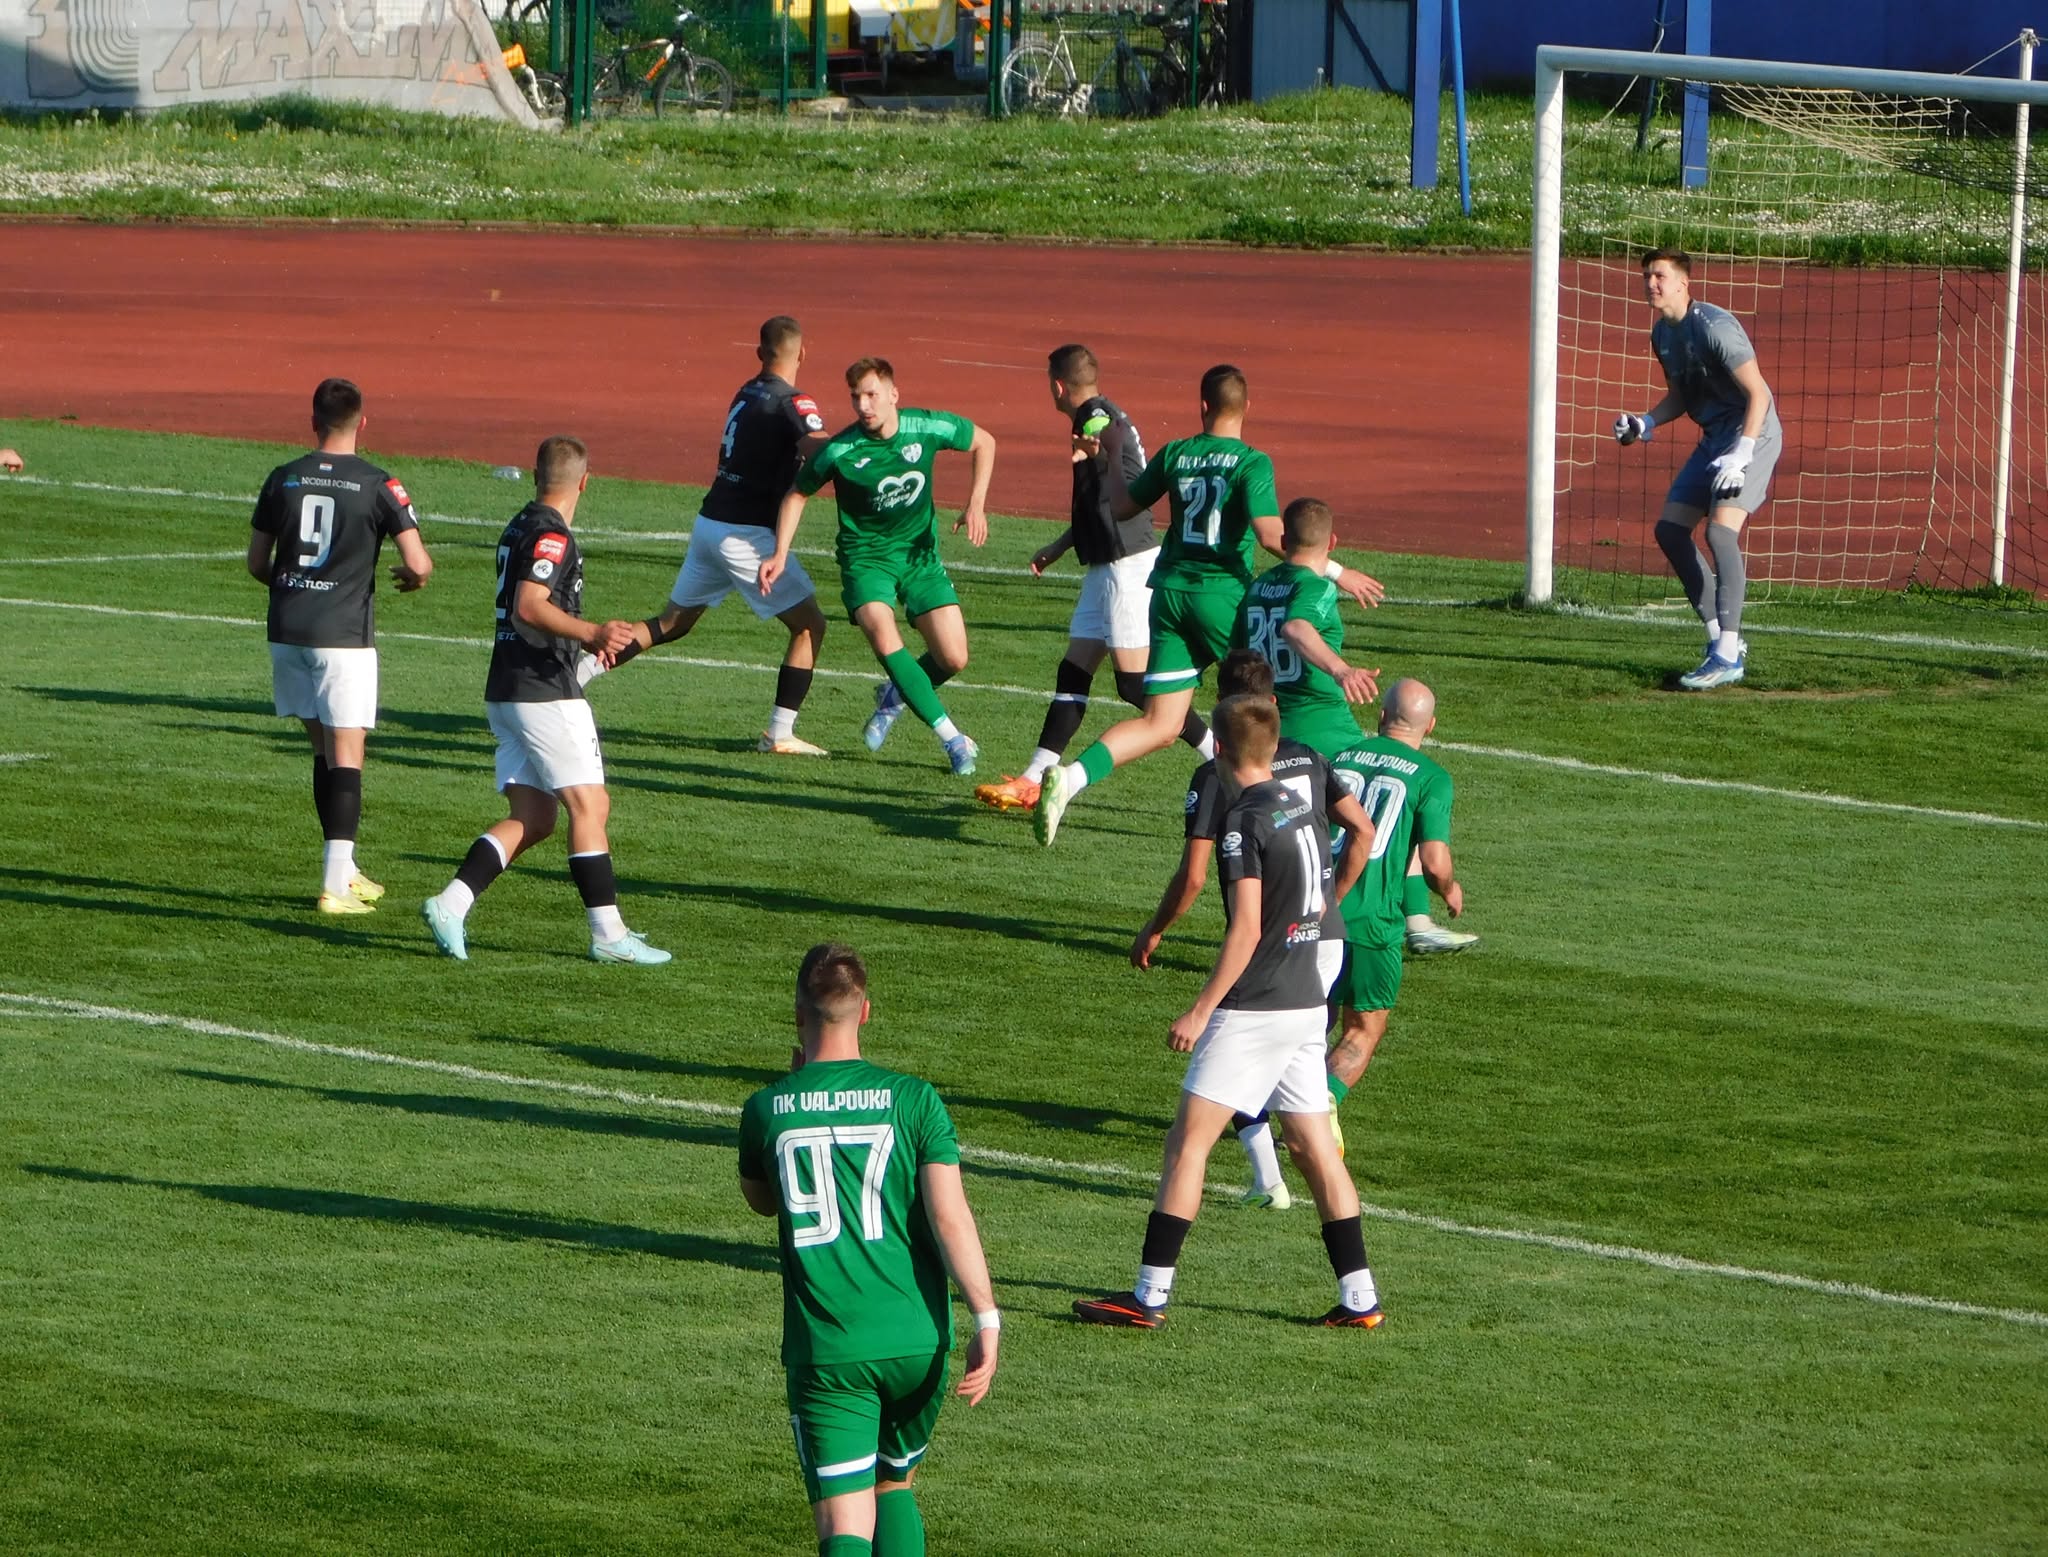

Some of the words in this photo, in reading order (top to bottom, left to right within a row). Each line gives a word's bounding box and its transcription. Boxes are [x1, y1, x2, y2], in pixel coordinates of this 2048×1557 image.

[721, 400, 747, 458] 4
[299, 494, 336, 568] 9
[1178, 475, 1228, 546] 21
[1247, 606, 1303, 683] 36
[1296, 825, 1324, 918] 11
[773, 1093, 796, 1115] NK
[800, 1089, 892, 1112] VALPOVKA
[774, 1124, 896, 1249] 97
